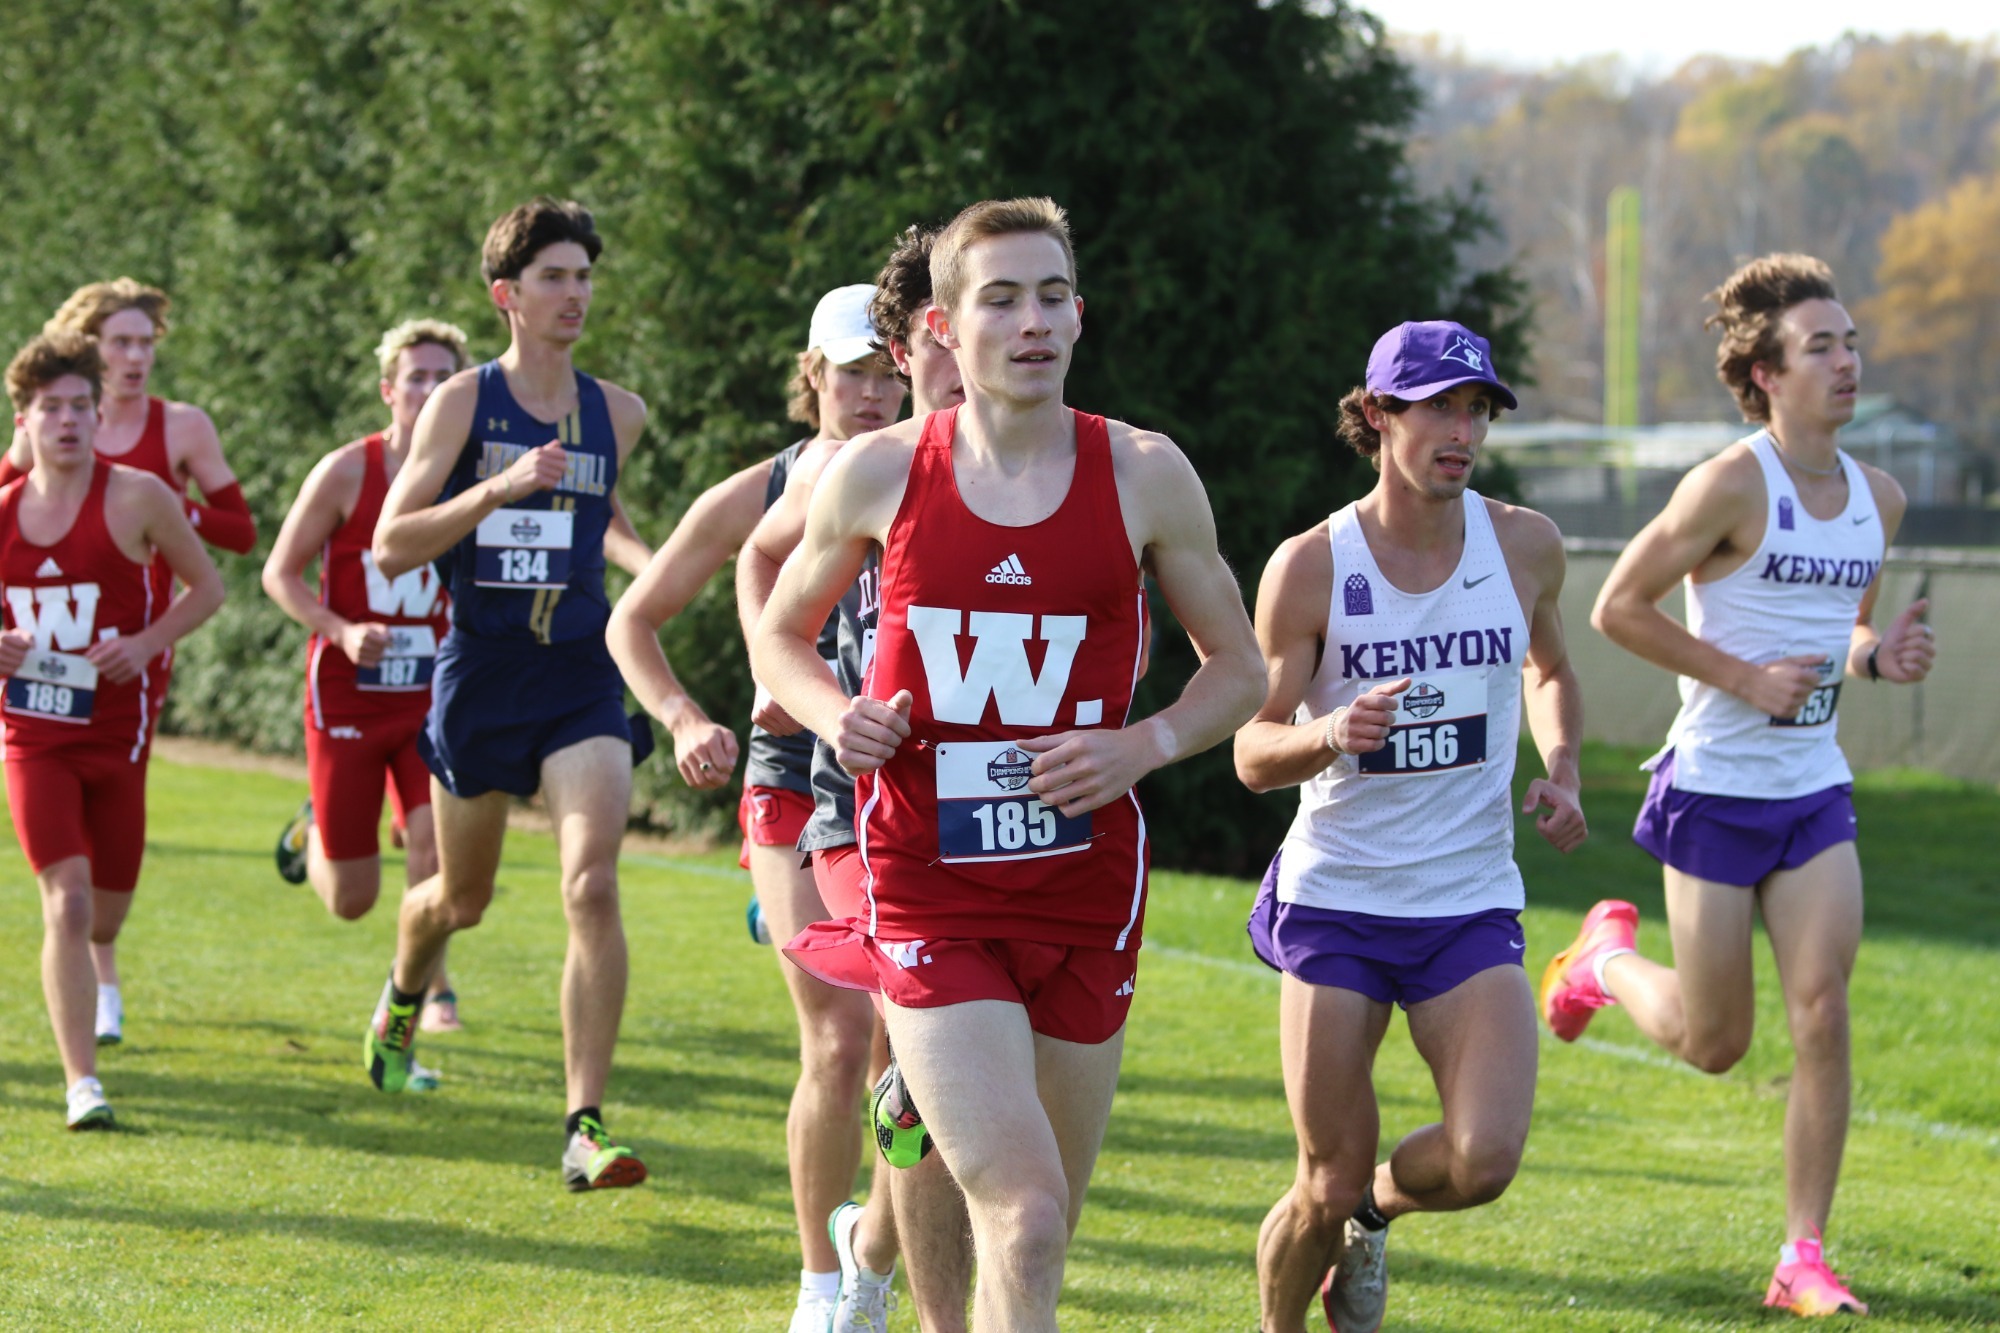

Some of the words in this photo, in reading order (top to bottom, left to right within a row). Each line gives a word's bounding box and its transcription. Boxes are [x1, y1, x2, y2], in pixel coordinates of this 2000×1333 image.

[498, 549, 549, 582] 134
[985, 571, 1032, 586] adidas
[1760, 553, 1882, 588] KENYON
[907, 604, 1103, 727] W.
[1341, 627, 1512, 679] KENYON
[378, 658, 418, 685] 187
[25, 682, 73, 716] 189
[1388, 724, 1458, 769] 156
[972, 801, 1056, 850] 185
